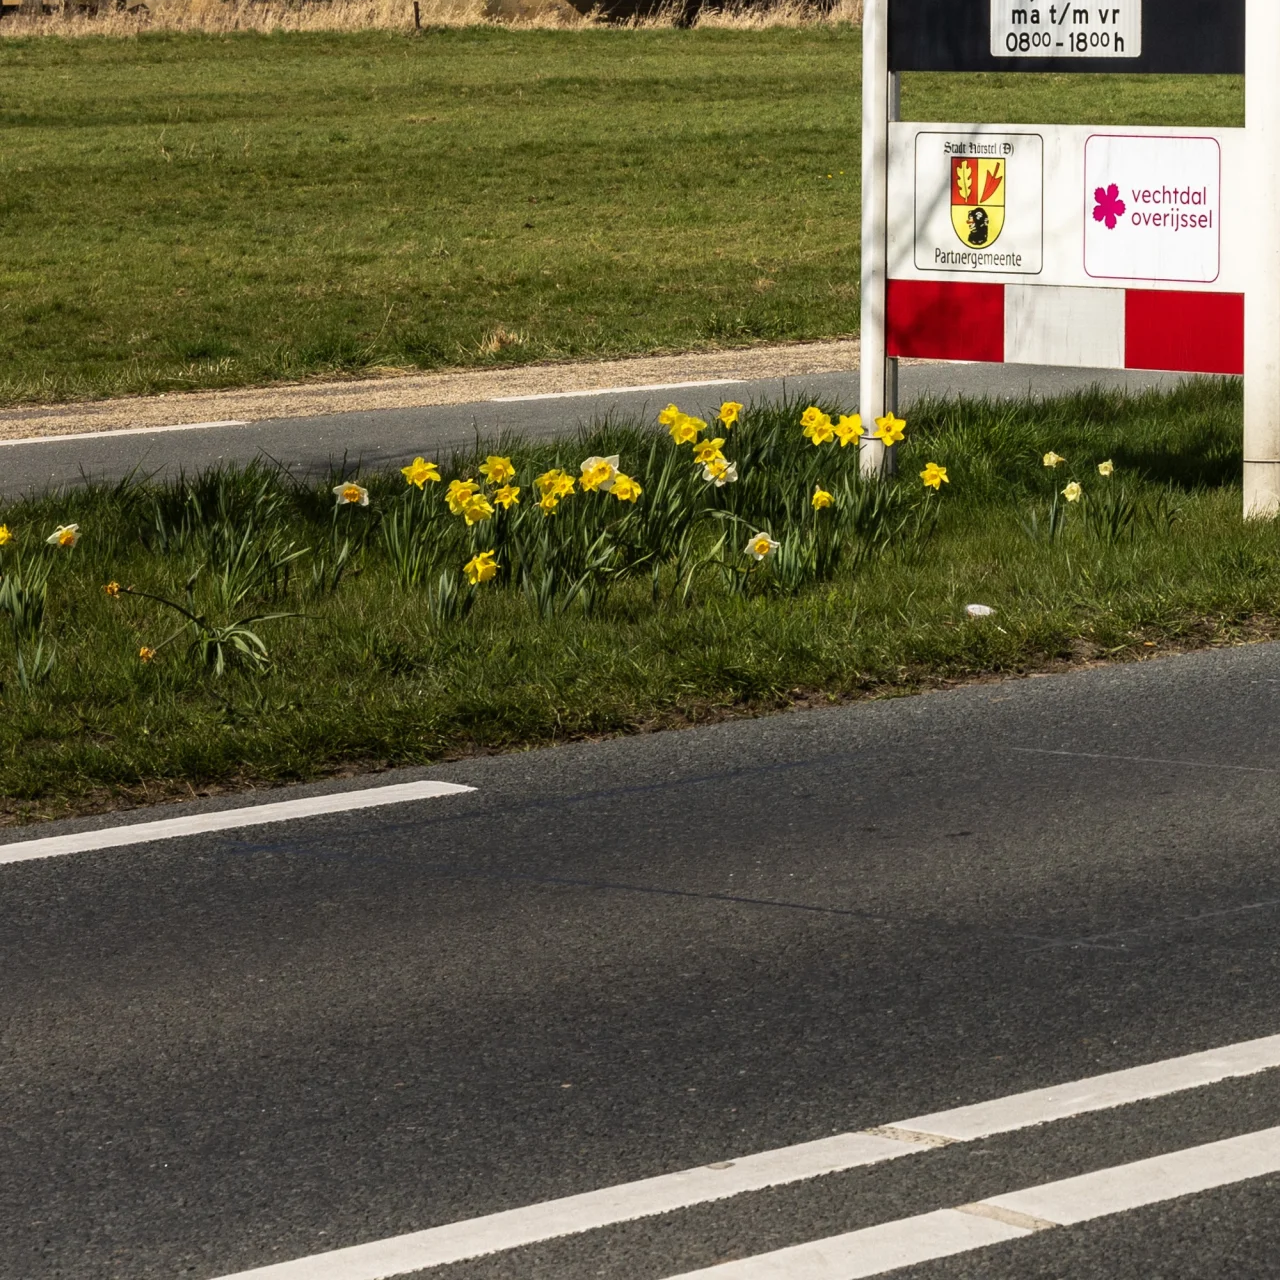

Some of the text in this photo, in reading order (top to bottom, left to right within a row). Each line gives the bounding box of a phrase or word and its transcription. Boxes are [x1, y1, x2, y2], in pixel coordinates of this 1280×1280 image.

[1011, 2, 1120, 25] ma t/m vr
[944, 141, 966, 155] Stadt
[1131, 185, 1207, 205] vechtdal
[1131, 208, 1213, 232] overijssel
[934, 247, 1022, 268] Partnergemeente
